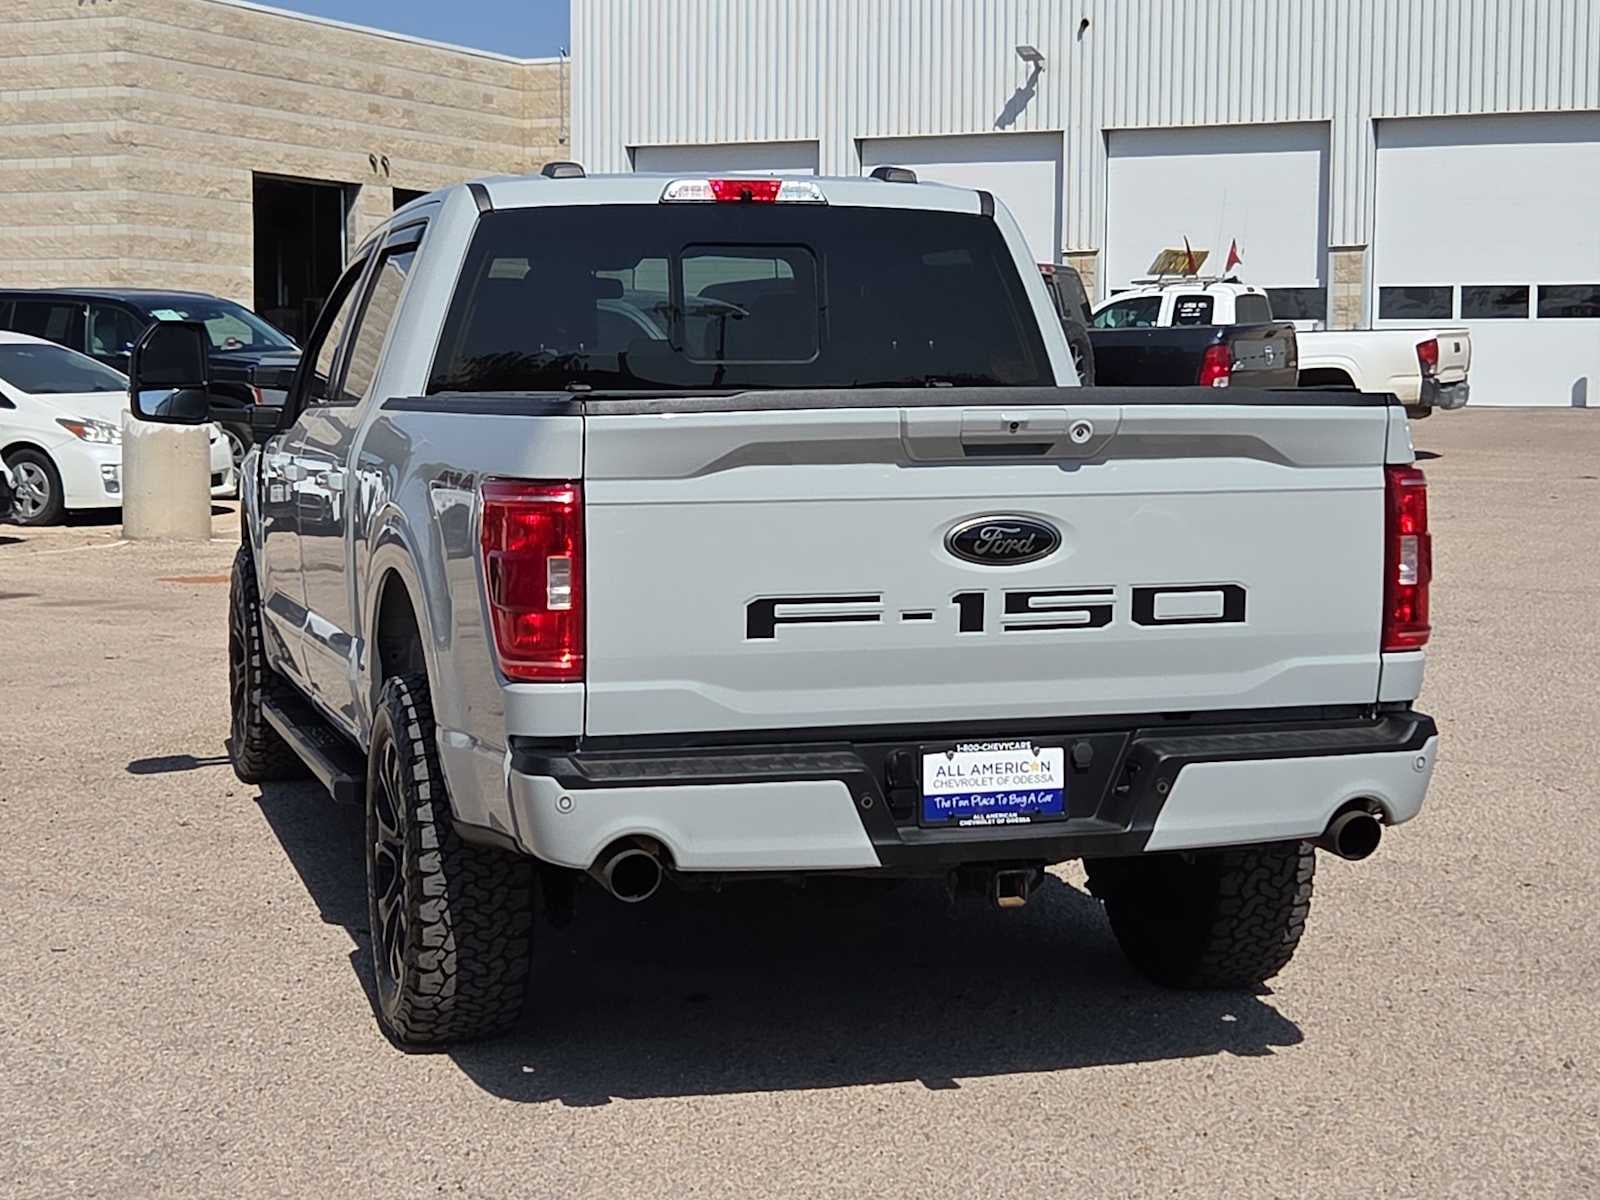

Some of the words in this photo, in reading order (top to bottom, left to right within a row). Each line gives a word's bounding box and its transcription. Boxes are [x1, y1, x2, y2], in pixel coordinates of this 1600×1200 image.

[973, 525, 1036, 554] Ford
[744, 581, 1248, 640] F-150
[936, 765, 965, 777] ALL
[933, 776, 993, 789] CHEVROLET
[996, 776, 1010, 786] OF
[1013, 774, 1054, 784] ODESSA
[934, 797, 951, 809] The
[970, 794, 995, 807] Place
[996, 794, 1008, 805] To
[1009, 793, 1027, 807] Buy
[1028, 792, 1036, 804] A
[1038, 792, 1053, 802] Car
